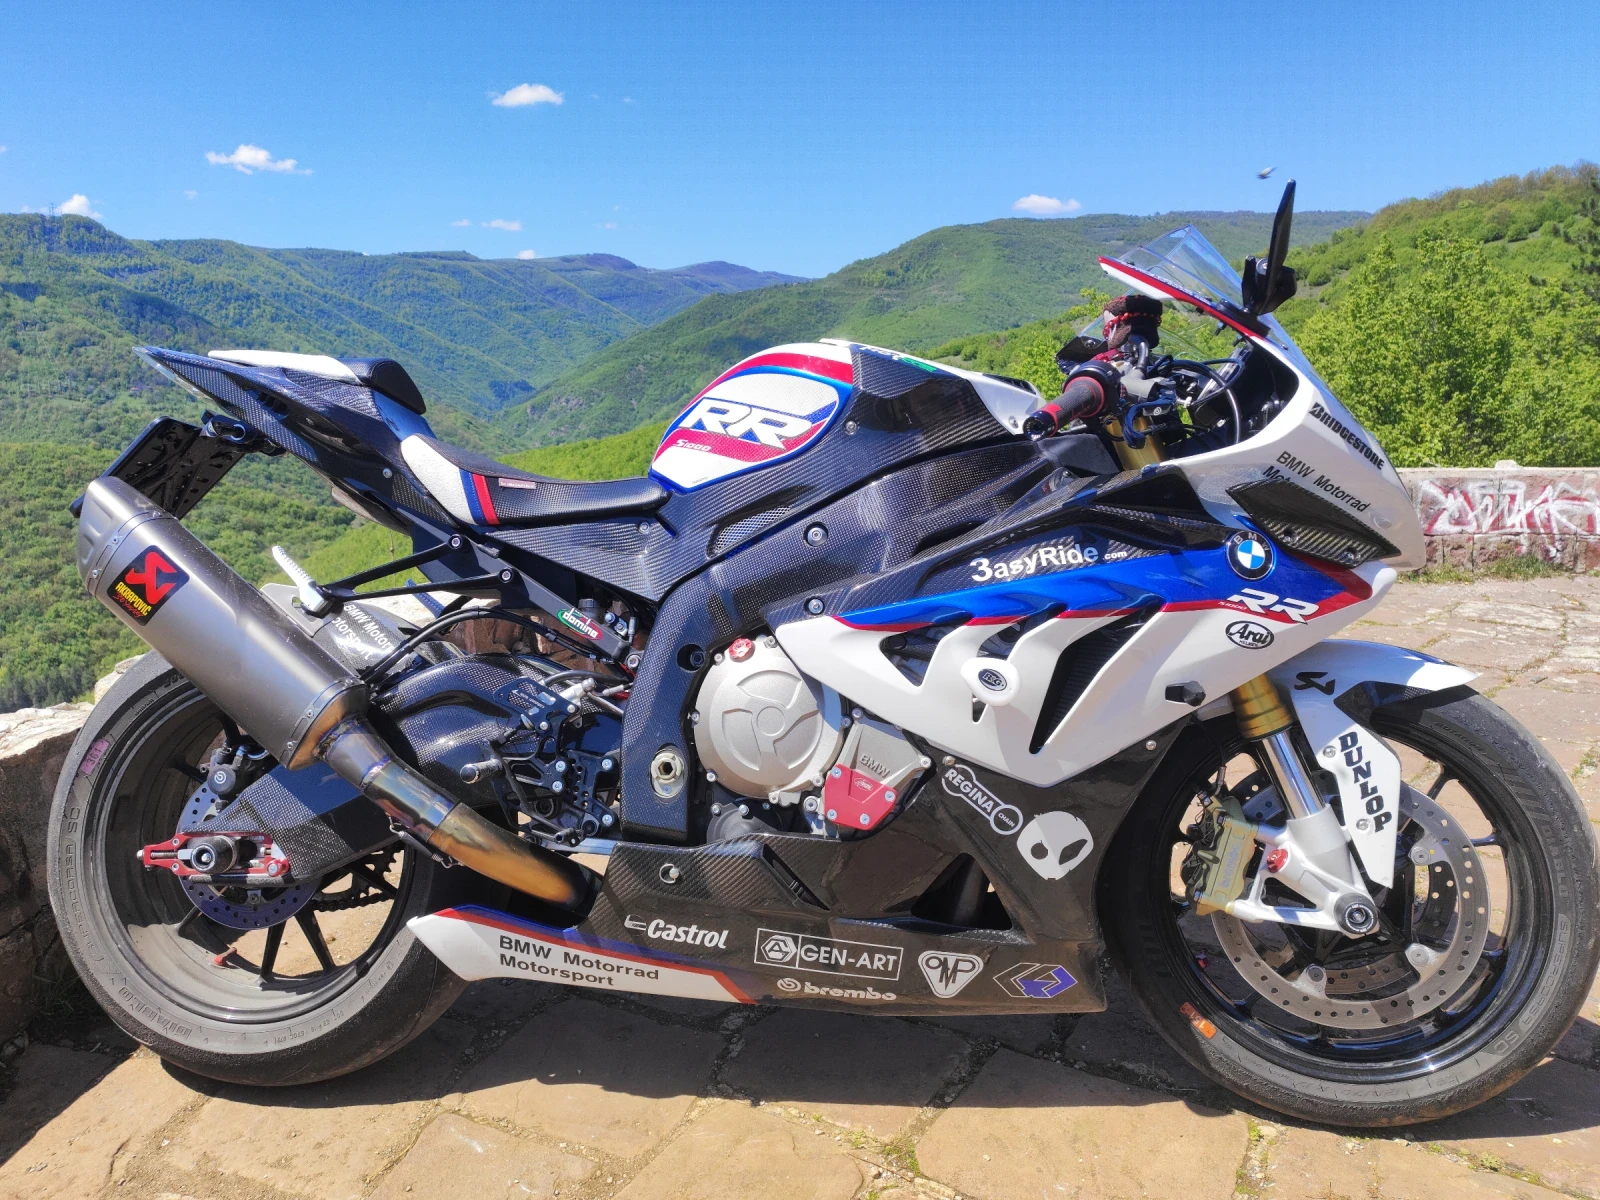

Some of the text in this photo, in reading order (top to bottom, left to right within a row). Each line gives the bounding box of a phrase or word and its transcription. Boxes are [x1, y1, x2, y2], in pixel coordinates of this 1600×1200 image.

[678, 398, 813, 451] RR
[1308, 402, 1385, 471] BRIDGESTONE
[673, 438, 712, 452] S1000
[1276, 450, 1315, 478] BMW
[1313, 474, 1371, 512] Motorrad
[1227, 587, 1319, 626] RR
[344, 604, 395, 650] BMW Motor
[562, 608, 599, 639] domino
[1229, 623, 1270, 645] Arai
[860, 755, 891, 778] BMW
[1338, 731, 1393, 833] DUNLOP
[945, 768, 1016, 828] REGINA CHAIN
[647, 919, 729, 949] Castrol
[499, 934, 660, 981] BMW Motorrad
[499, 954, 615, 987] Motorsport
[800, 944, 898, 972] GEN-ART
[803, 982, 897, 1001] brembo
[1495, 1031, 1520, 1053] SC
